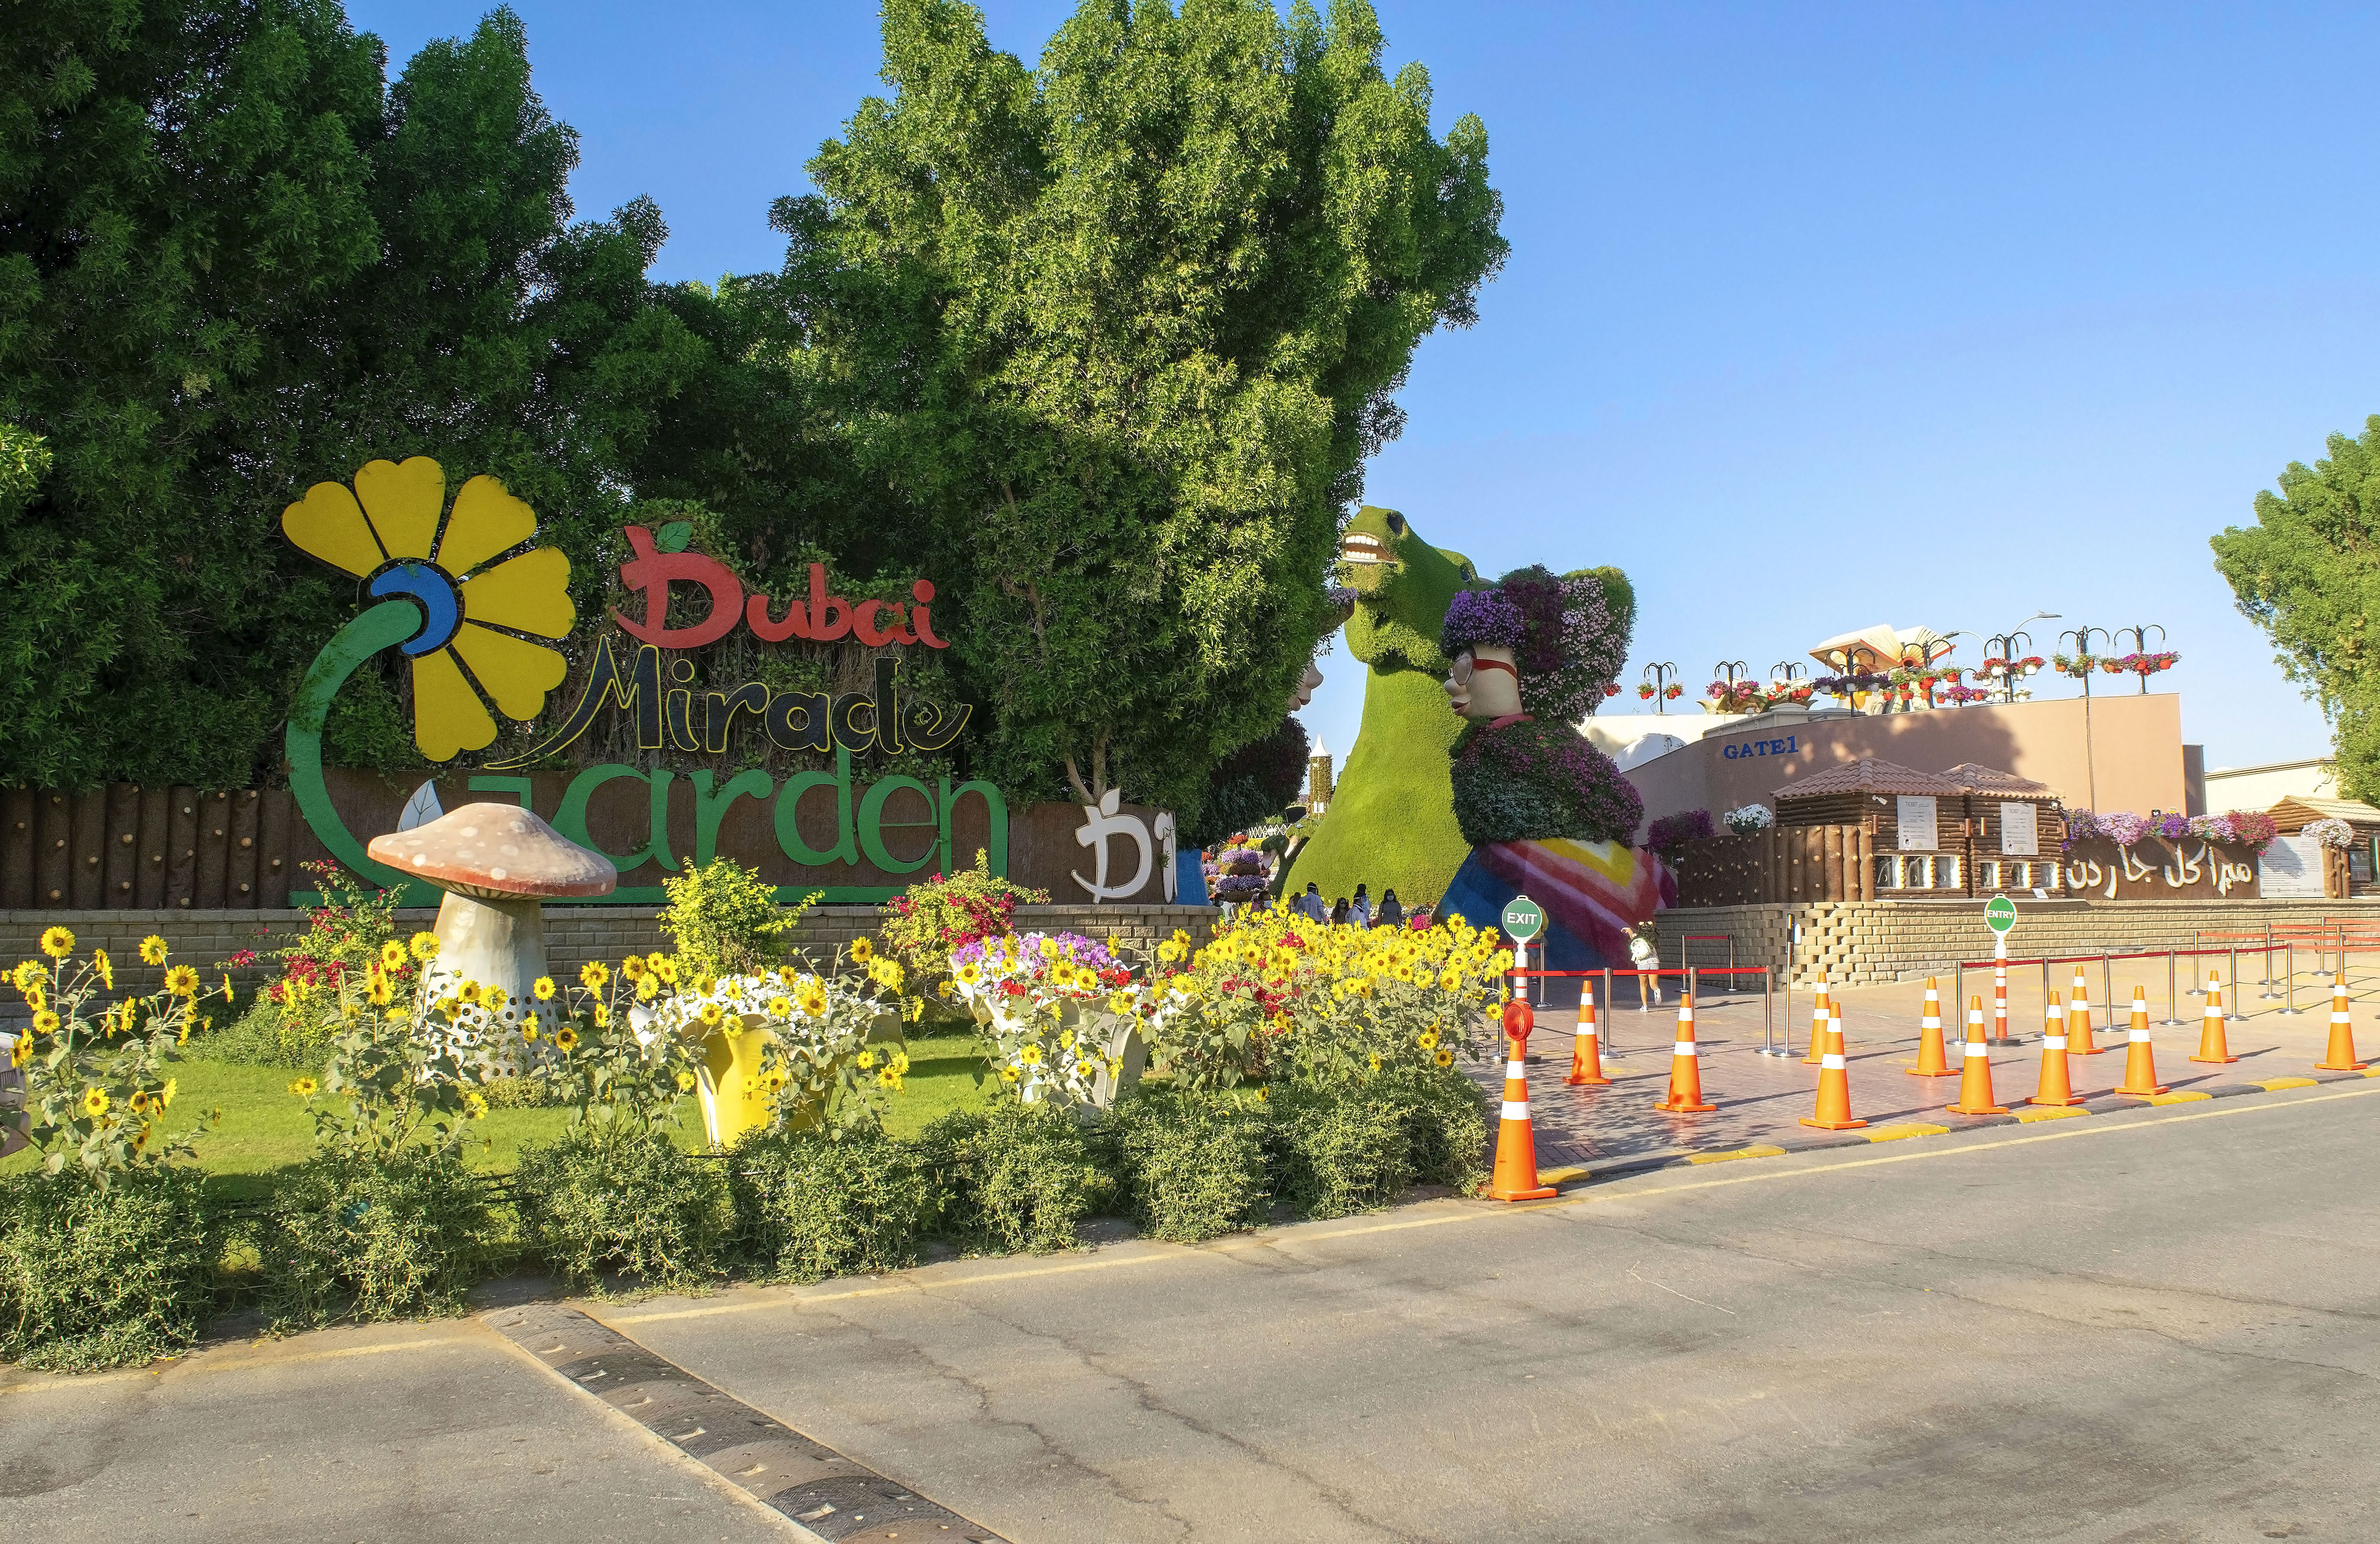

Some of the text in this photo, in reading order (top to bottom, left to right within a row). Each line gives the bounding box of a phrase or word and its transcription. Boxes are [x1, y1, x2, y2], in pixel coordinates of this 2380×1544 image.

[610, 525, 950, 648] Dubai
[483, 634, 973, 770] Miracle
[2065, 844, 2157, 899] جاردن
[1507, 912, 1537, 925] EXIT
[1987, 909, 2014, 919] ENTRY
